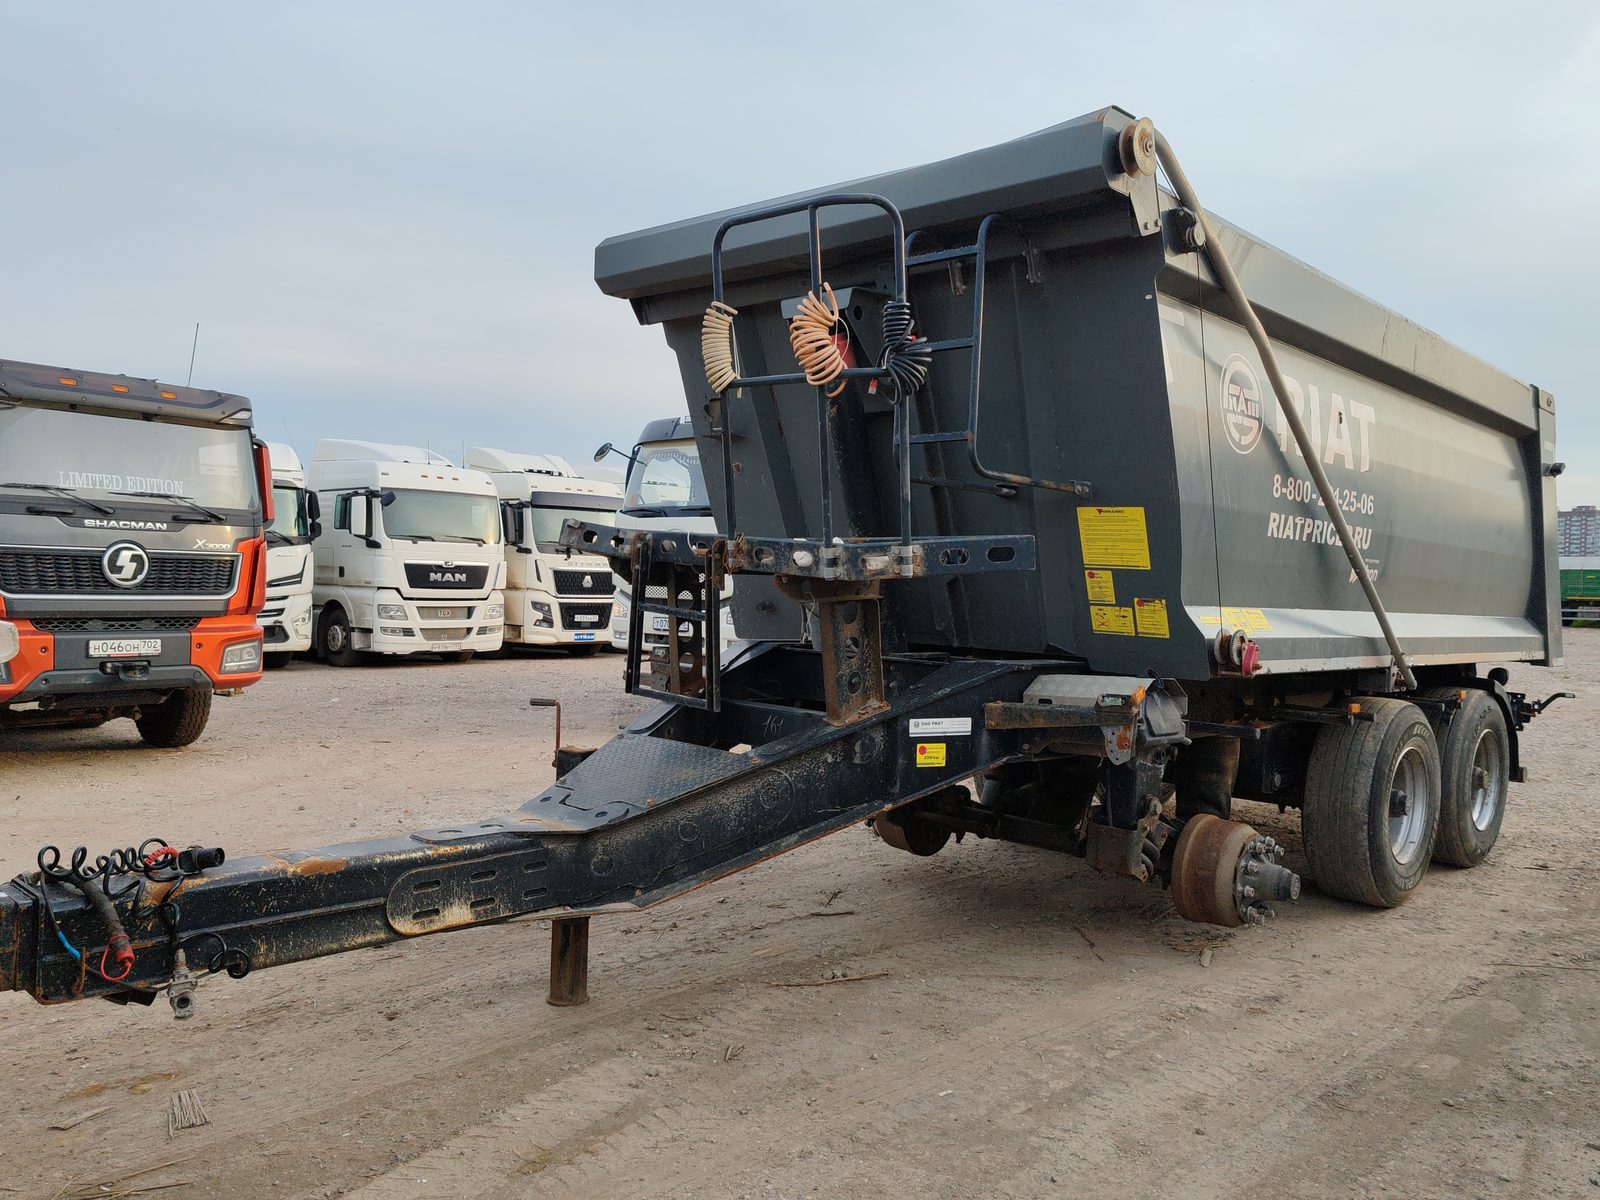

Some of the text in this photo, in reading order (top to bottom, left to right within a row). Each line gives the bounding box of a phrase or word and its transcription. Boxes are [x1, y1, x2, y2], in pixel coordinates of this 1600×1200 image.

[58, 471, 184, 495] LIMITED EDITION
[84, 519, 168, 531] SHACMAN
[193, 538, 231, 551] X3000
[429, 572, 467, 582] MAN
[142, 640, 158, 649] 702
